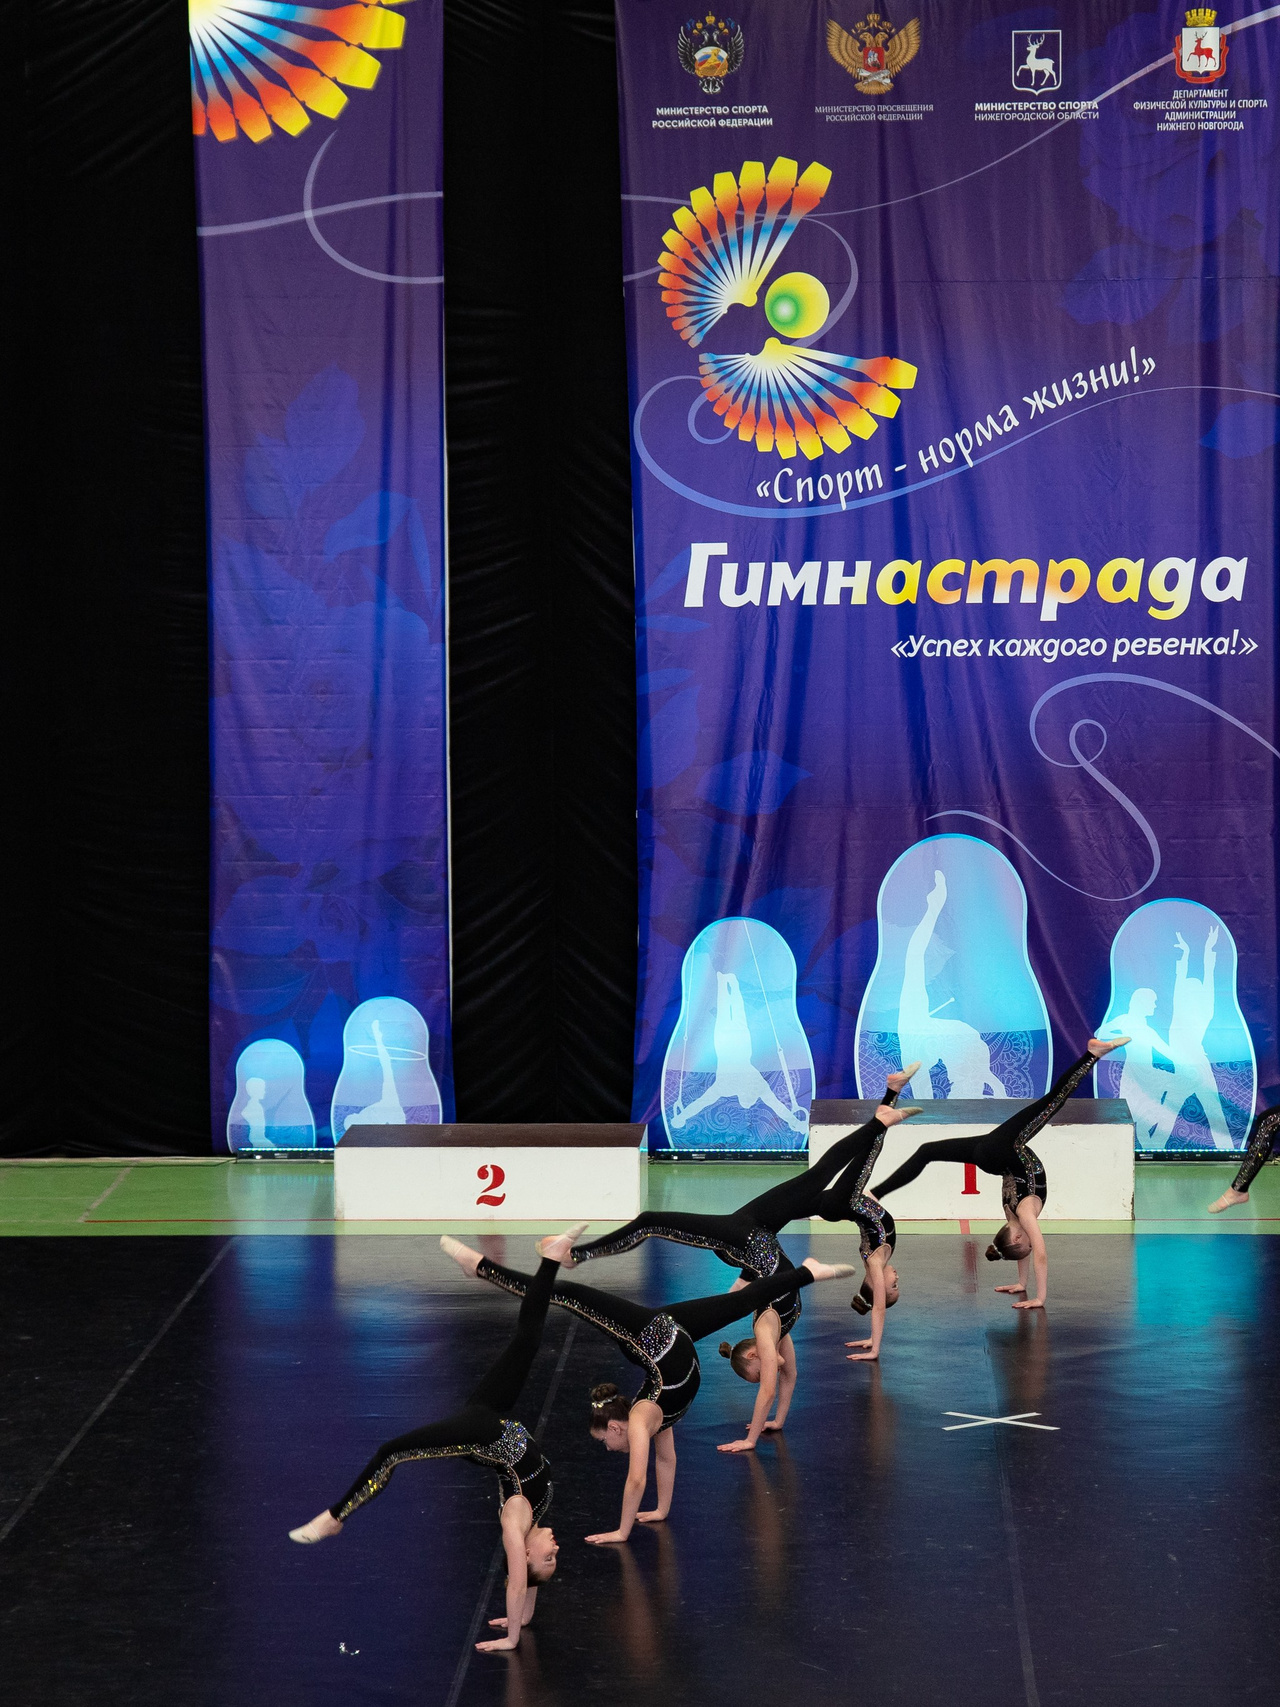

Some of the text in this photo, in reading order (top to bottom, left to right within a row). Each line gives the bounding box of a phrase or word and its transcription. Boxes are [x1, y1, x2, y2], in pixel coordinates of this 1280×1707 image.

[1173, 89, 1229, 100] ДЕПАРТАМЕНТ
[815, 104, 934, 113] МИНИСТЕРСТВО ПРОСВЕЩЕНИЯ
[974, 101, 1099, 111] МИНИСТЕРСТВО СПОРТА
[1133, 99, 1268, 110] ФИЗИЧЕСКОЙ КУЛЬТУРЫ И СПОРТА
[656, 105, 769, 116] МИНИСТЕРСТВО СПОРТА
[1165, 111, 1236, 121] АДМИНИСТРАЦИИ
[825, 113, 923, 122] РОССИЙСКОЙ ФЕДЕРАЦИИ
[974, 111, 1099, 122] НИЖЕГОРОДСКОЙ ОБЛАСТИ
[652, 118, 773, 129] РОССИЙСКОЙ ФЕДЕРАЦИИ
[1156, 121, 1244, 131] НИЖНЕГО НОВГОРОДА
[756, 464, 884, 511] «Спорт
[918, 405, 1020, 473] норма
[1022, 346, 1157, 421] жизни!»
[683, 542, 1249, 622] Гимнастрада
[890, 634, 983, 662] «Успех
[988, 638, 1107, 663] каждого
[476, 1164, 506, 1207] 2
